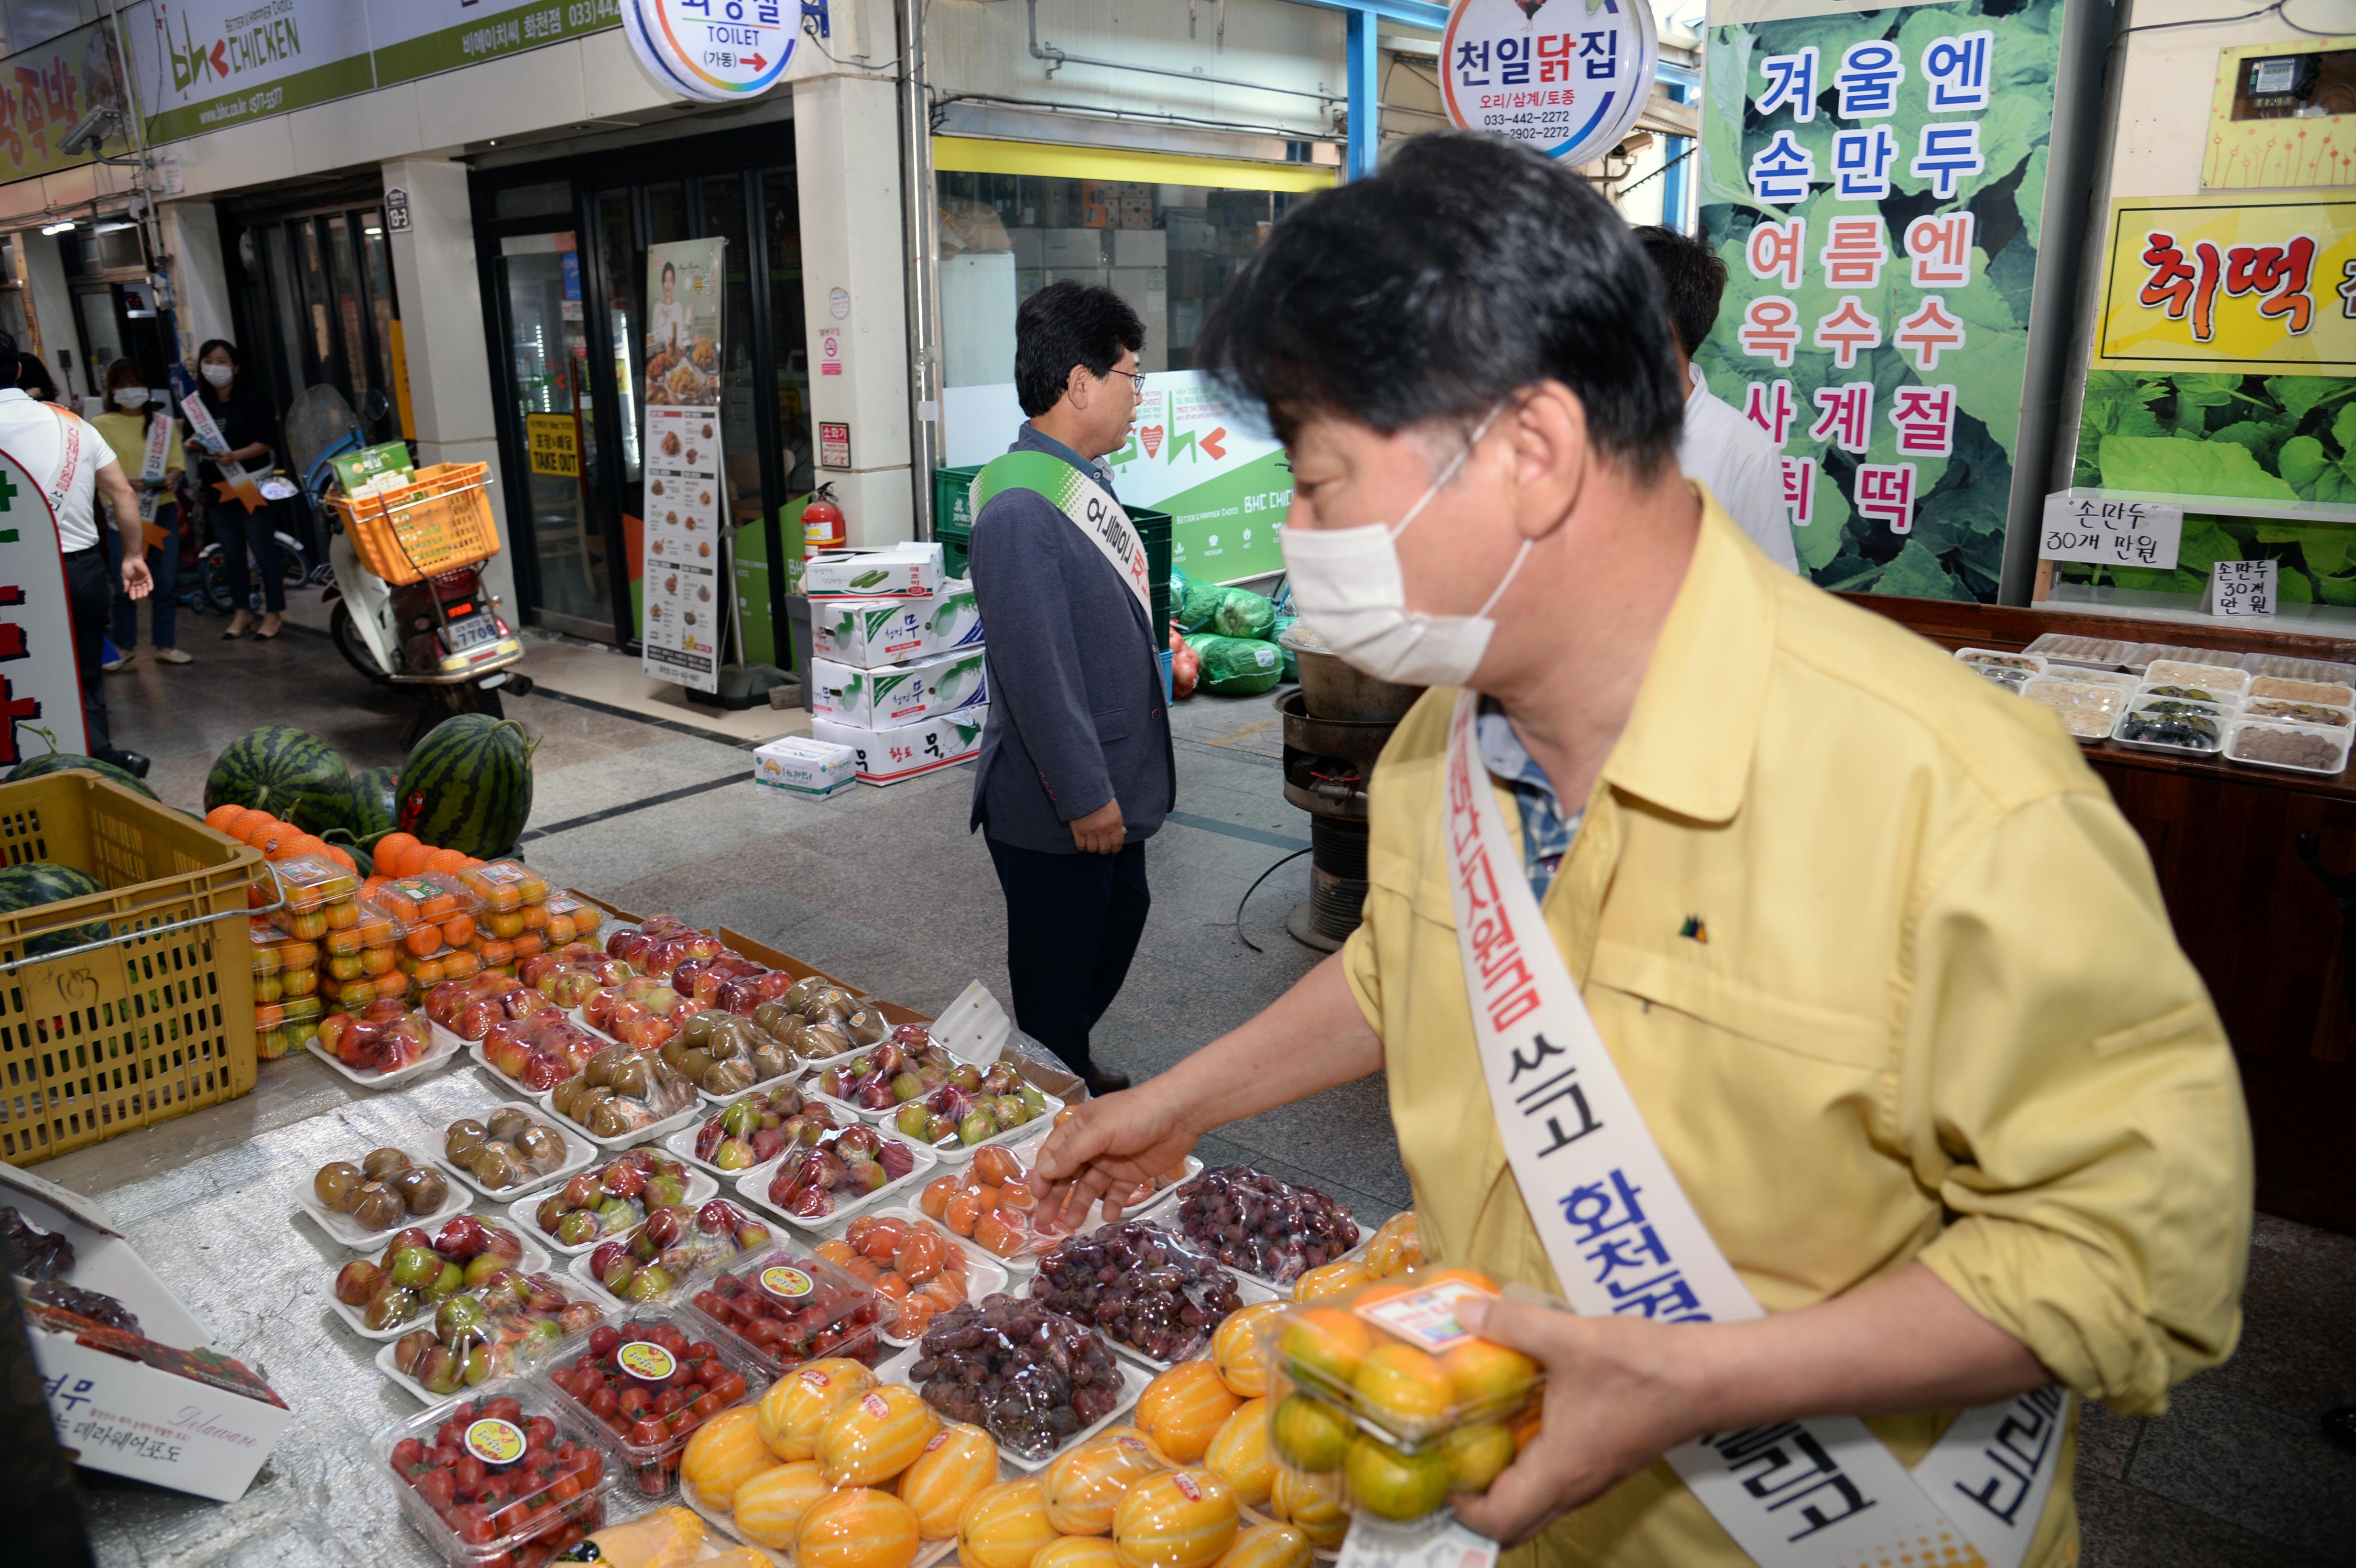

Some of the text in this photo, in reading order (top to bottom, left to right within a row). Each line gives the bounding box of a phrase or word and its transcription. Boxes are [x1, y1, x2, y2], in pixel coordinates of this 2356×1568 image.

[228, 16, 301, 74] CHICKEN
[462, 19, 520, 56] 비에이치씨
[524, 7, 562, 39] 화천점
[707, 25, 759, 46] TOILET
[703, 51, 737, 68] (가동)
[1456, 29, 1617, 87] 천일닭집
[1761, 37, 1987, 117] 겨울엔
[1479, 89, 1575, 109] 오리/삼계/토종
[1483, 110, 1570, 126] 033-442-2272
[1755, 128, 1978, 197] 손만두
[1752, 218, 1967, 283] 여름엔
[2140, 233, 2311, 340] 취떡
[1743, 301, 1960, 365] 옥수수
[823, 427, 847, 439] 소화기
[1746, 385, 1951, 451] 사계절
[534, 452, 577, 472] TAKE OUT
[1244, 493, 1267, 513] BHC
[1086, 497, 1134, 565] 오늘은
[2046, 531, 2157, 564] 30개 만원
[788, 558, 806, 575] BH
[909, 566, 920, 586] 애호박
[2218, 561, 2269, 582] 손만두
[2224, 582, 2264, 596] 30개
[904, 613, 920, 639] 무
[912, 679, 925, 703] 무
[889, 732, 939, 763] 황토 무
[1508, 1033, 1603, 1159] 쓰고
[73, 1420, 183, 1462] 데라웨어포도
[167, 1405, 259, 1448] Delaware
